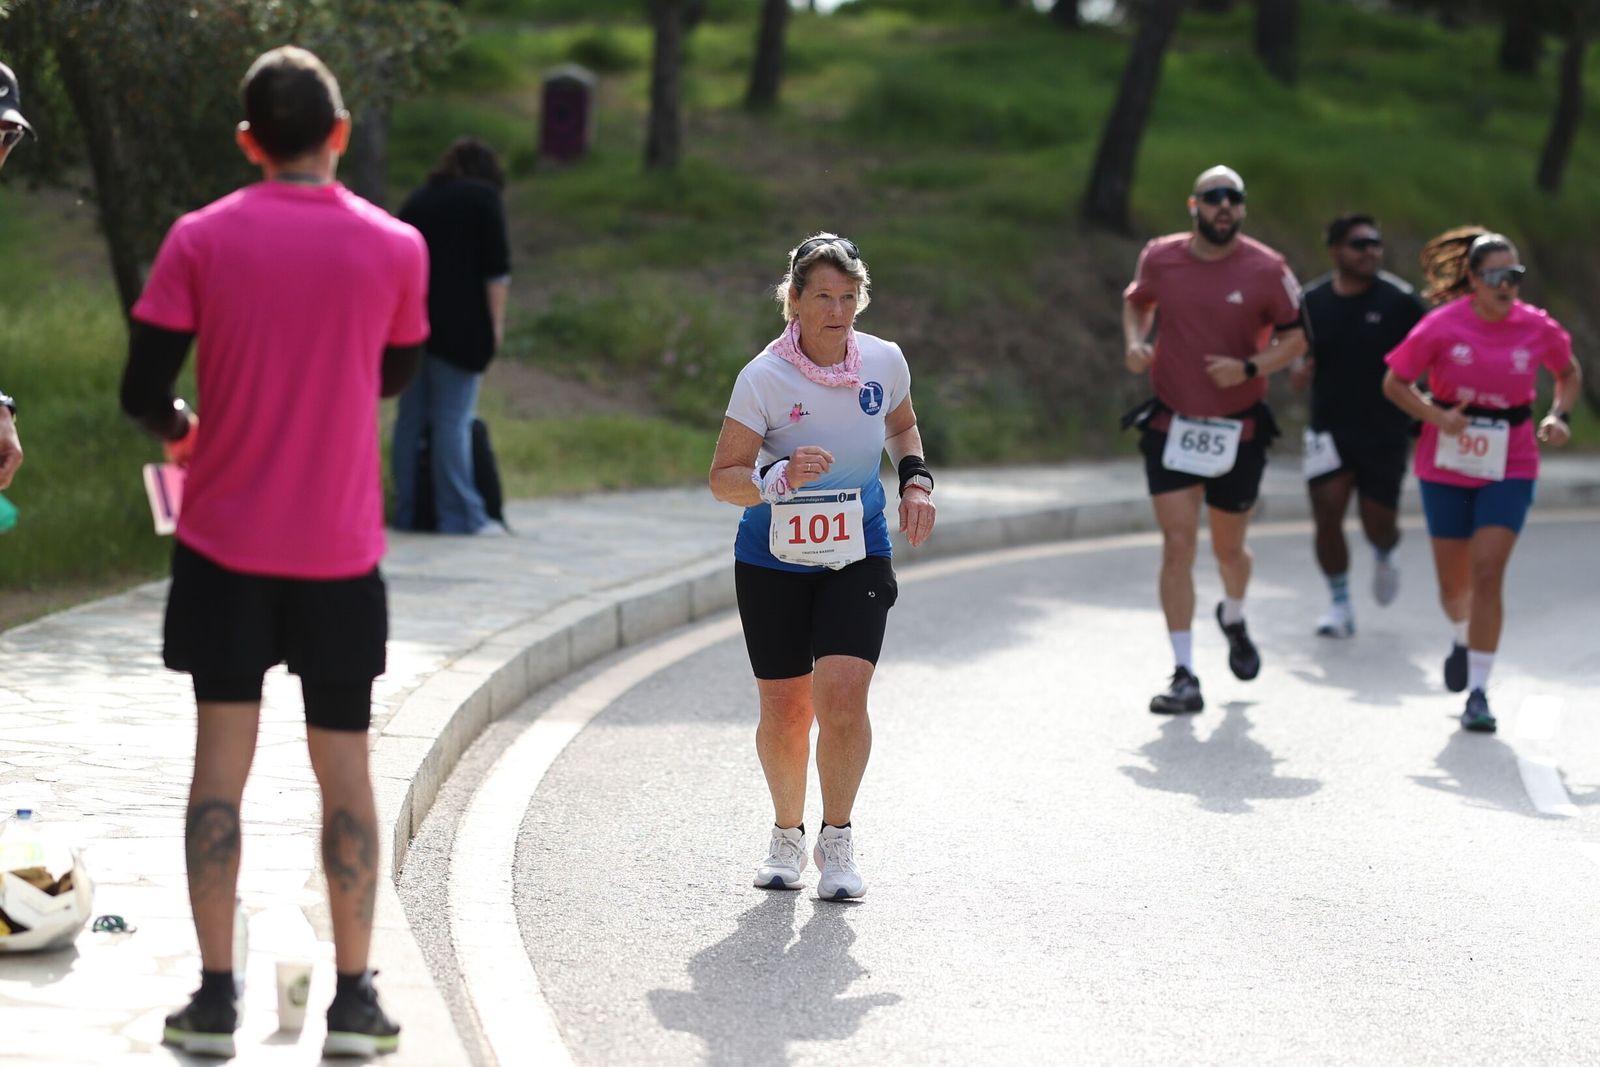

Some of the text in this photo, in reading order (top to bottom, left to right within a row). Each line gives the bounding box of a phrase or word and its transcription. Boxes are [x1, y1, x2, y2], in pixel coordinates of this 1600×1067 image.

[1180, 429, 1226, 455] 685
[1457, 434, 1489, 457] 90
[788, 512, 850, 544] 101
